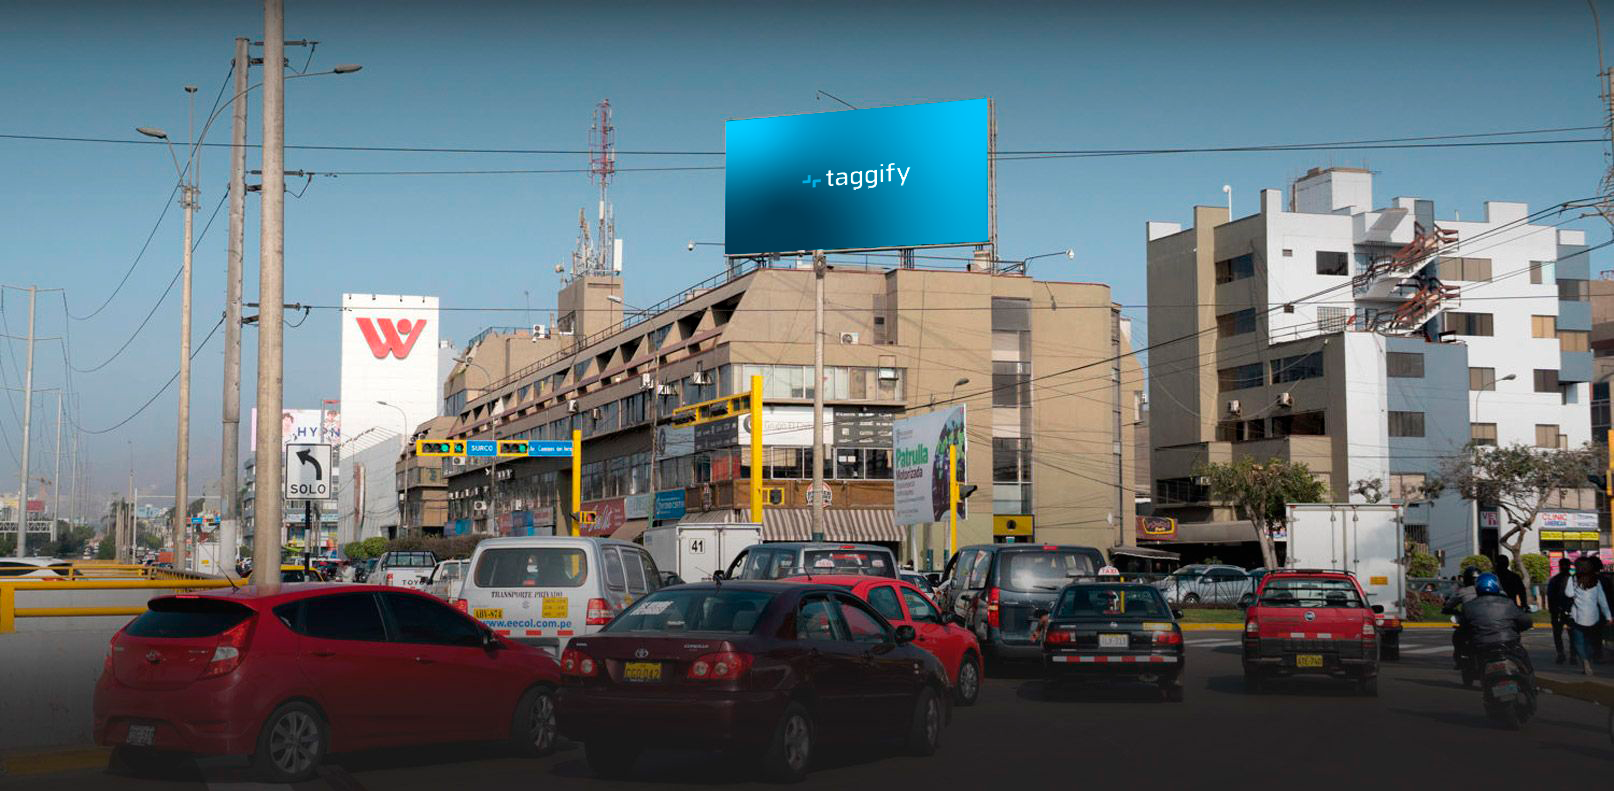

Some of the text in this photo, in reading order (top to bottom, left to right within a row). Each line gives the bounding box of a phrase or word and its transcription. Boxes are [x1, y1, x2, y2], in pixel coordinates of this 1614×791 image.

[825, 162, 911, 190] taggify
[471, 444, 494, 452] SURCO
[895, 443, 929, 468] Patrulla
[895, 466, 923, 481] Motorizada
[290, 484, 326, 495] SOLO
[691, 540, 704, 553] 41
